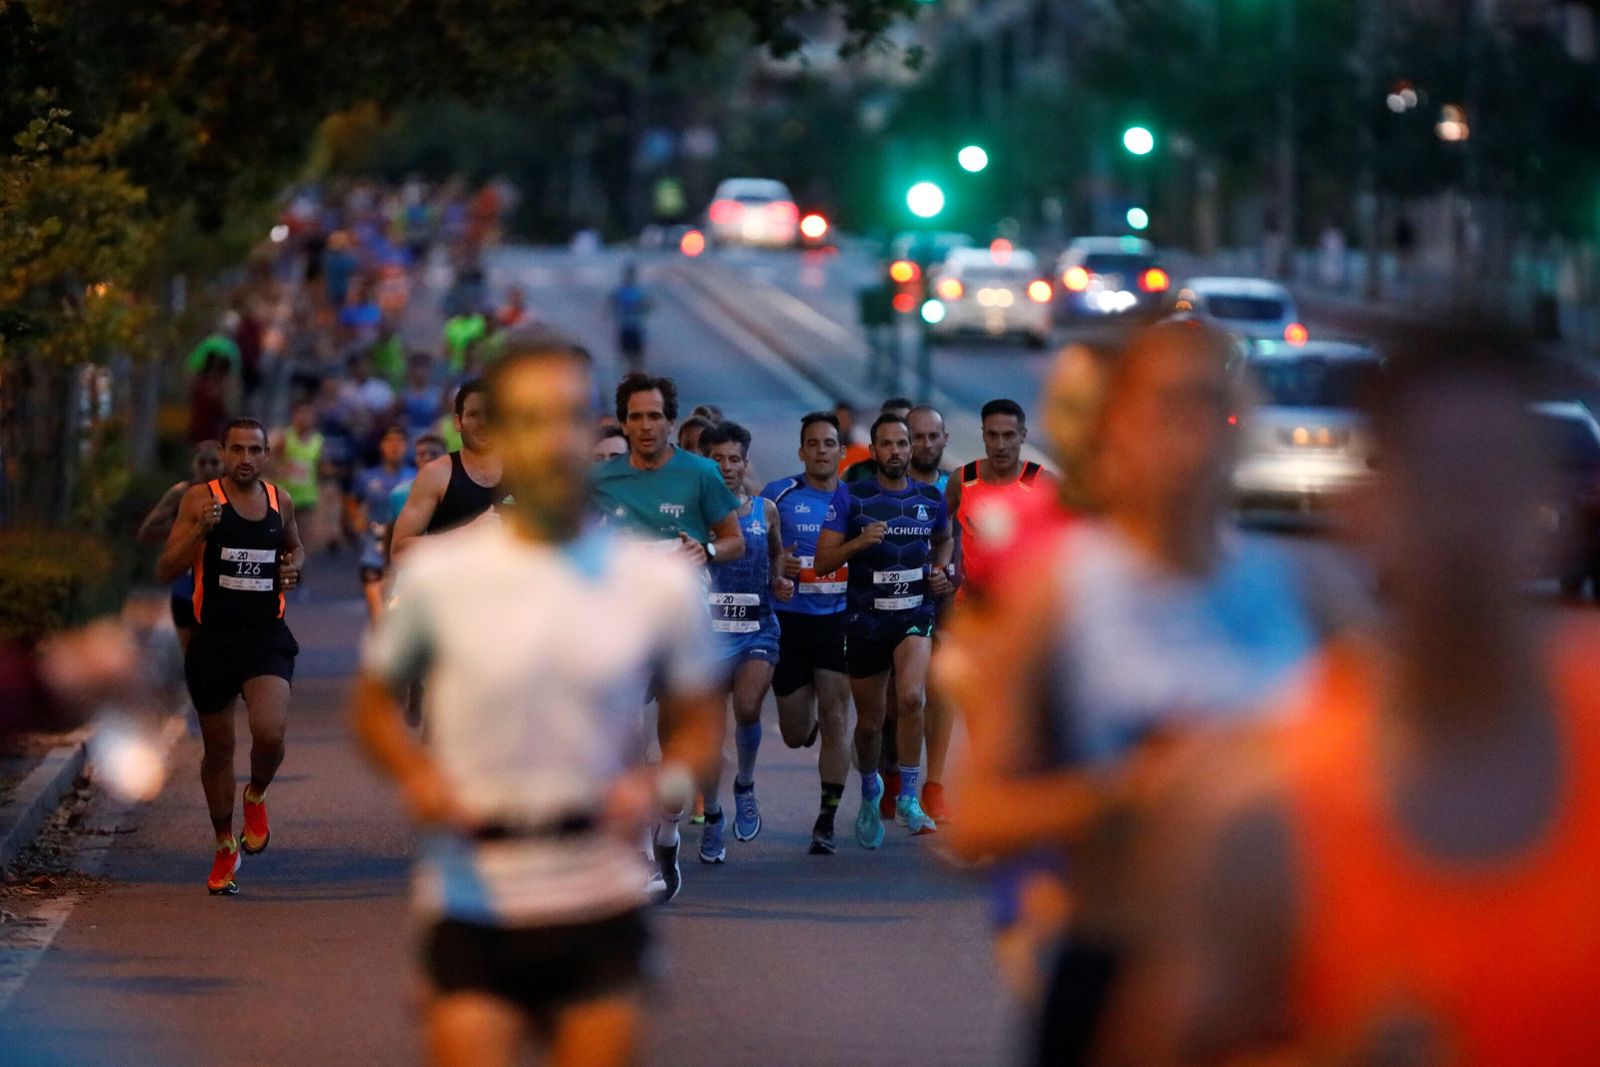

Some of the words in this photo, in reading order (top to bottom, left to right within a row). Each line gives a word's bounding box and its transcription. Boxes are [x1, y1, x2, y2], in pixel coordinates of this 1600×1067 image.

[237, 551, 249, 560] 20
[236, 562, 261, 575] 126
[889, 573, 900, 582] 20
[893, 582, 909, 595] 22
[723, 595, 734, 603] 20
[723, 605, 747, 617] 118
